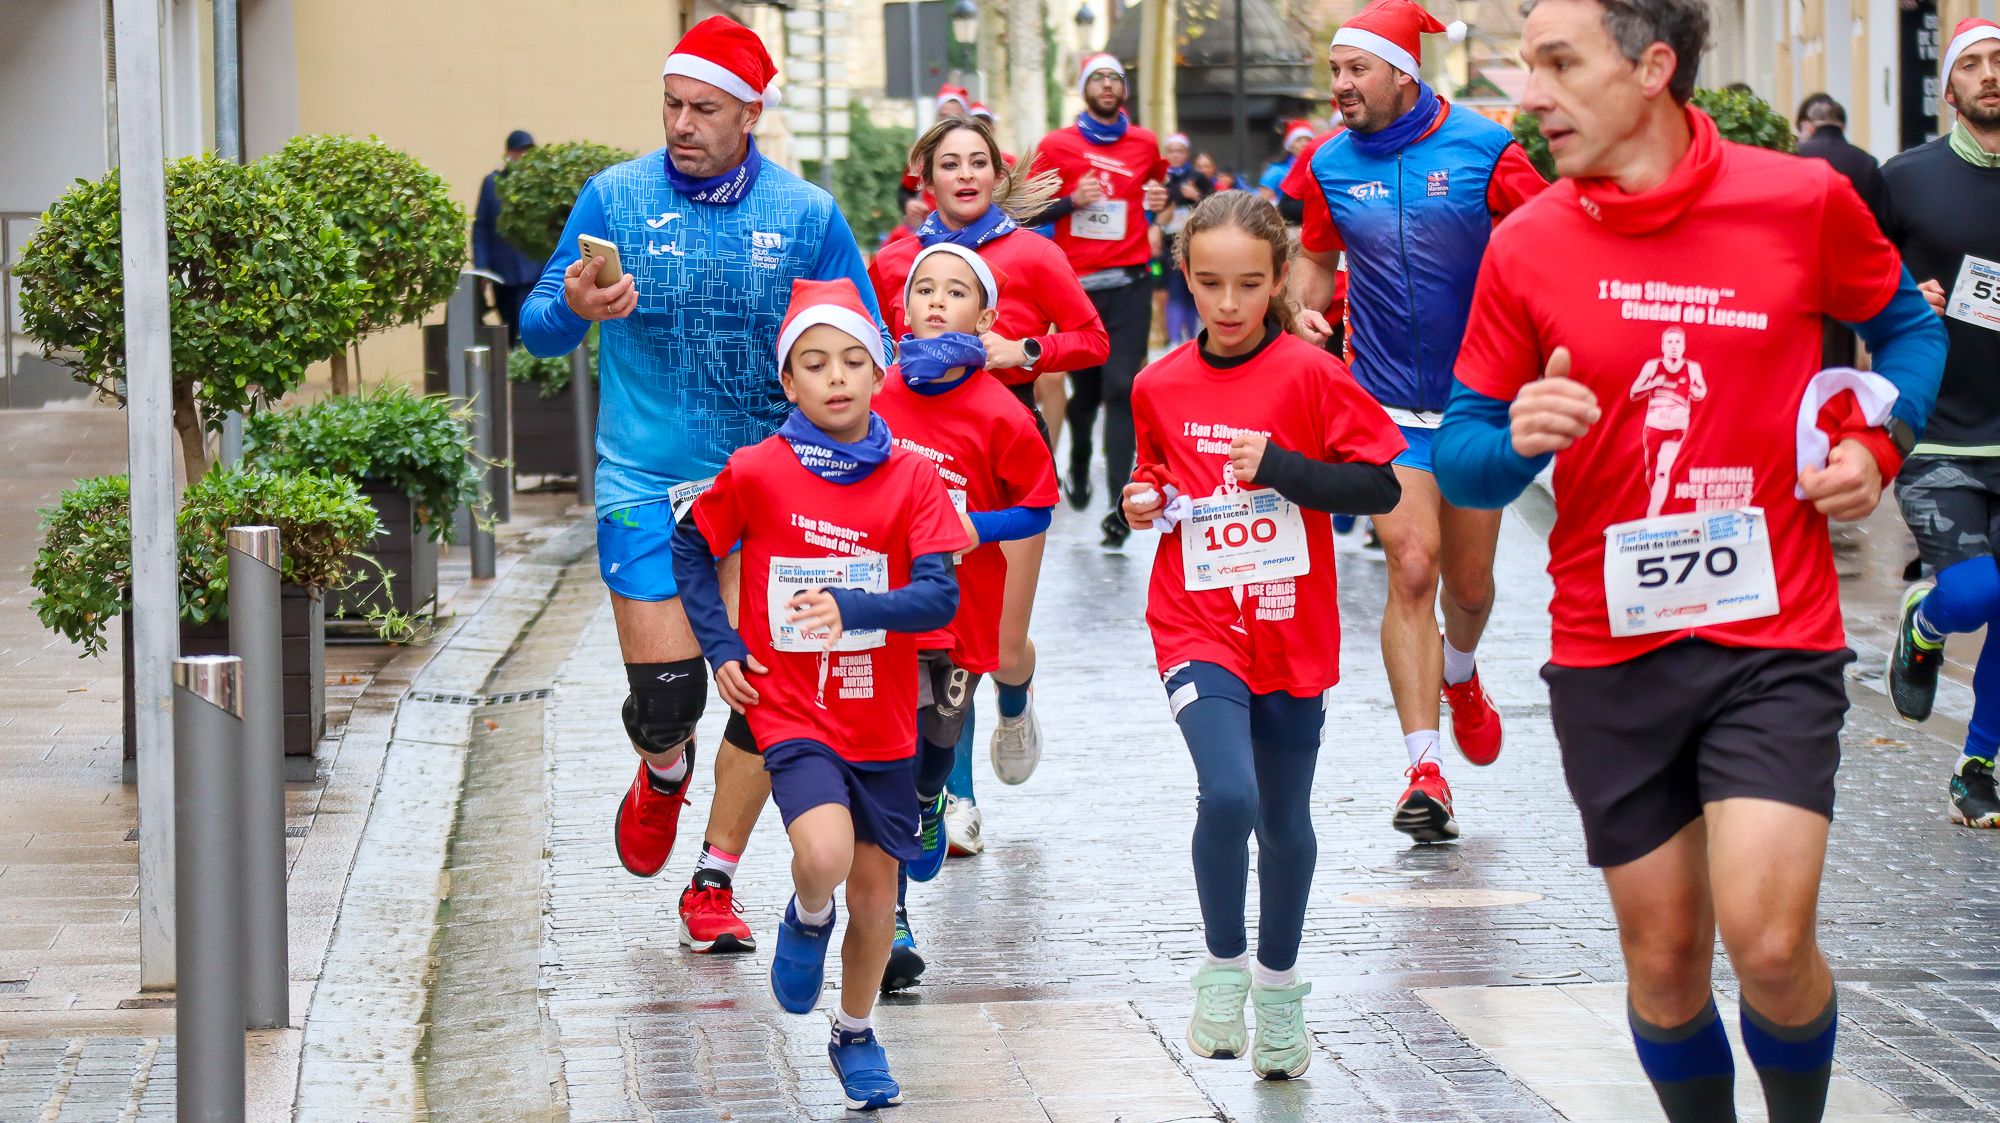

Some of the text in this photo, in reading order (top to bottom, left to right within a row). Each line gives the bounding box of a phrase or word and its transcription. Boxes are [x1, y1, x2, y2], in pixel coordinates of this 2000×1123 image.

[1088, 214, 1109, 224] 40
[752, 247, 769, 256] Club
[752, 261, 777, 270] Lucena
[1599, 280, 1608, 300] I
[1610, 280, 1643, 300] San
[1644, 281, 1720, 306] Silvestre
[1621, 300, 1769, 331] Ciudad de Lucena
[1184, 422, 1190, 437] I
[1191, 422, 1212, 438] San
[900, 438, 945, 463] Silvestre
[1689, 467, 1754, 485] MEMORIAL
[679, 490, 691, 498] San
[1675, 482, 1753, 500] JOSE CARLOS
[1203, 504, 1232, 515] Silvestre
[1192, 514, 1213, 524] Ciudad
[1223, 510, 1249, 519] Lucena
[791, 513, 798, 526] I
[798, 515, 817, 531] San
[818, 520, 860, 542] Silvestre
[1204, 518, 1277, 551] 100
[804, 530, 839, 551] Ciudad
[838, 540, 851, 554] de
[1262, 556, 1295, 566] enerplus
[1637, 547, 1738, 588] 570
[794, 567, 827, 577] Silvestre
[778, 575, 843, 584] Ciudad de Lucena
[1265, 582, 1296, 597] CARLOS
[1258, 595, 1296, 609] HURTADO
[839, 653, 872, 667] MEMORIAL
[832, 664, 873, 677] JOSE CARLOS
[843, 676, 873, 688] HURTADO
[839, 687, 874, 699] MARJALIZO
